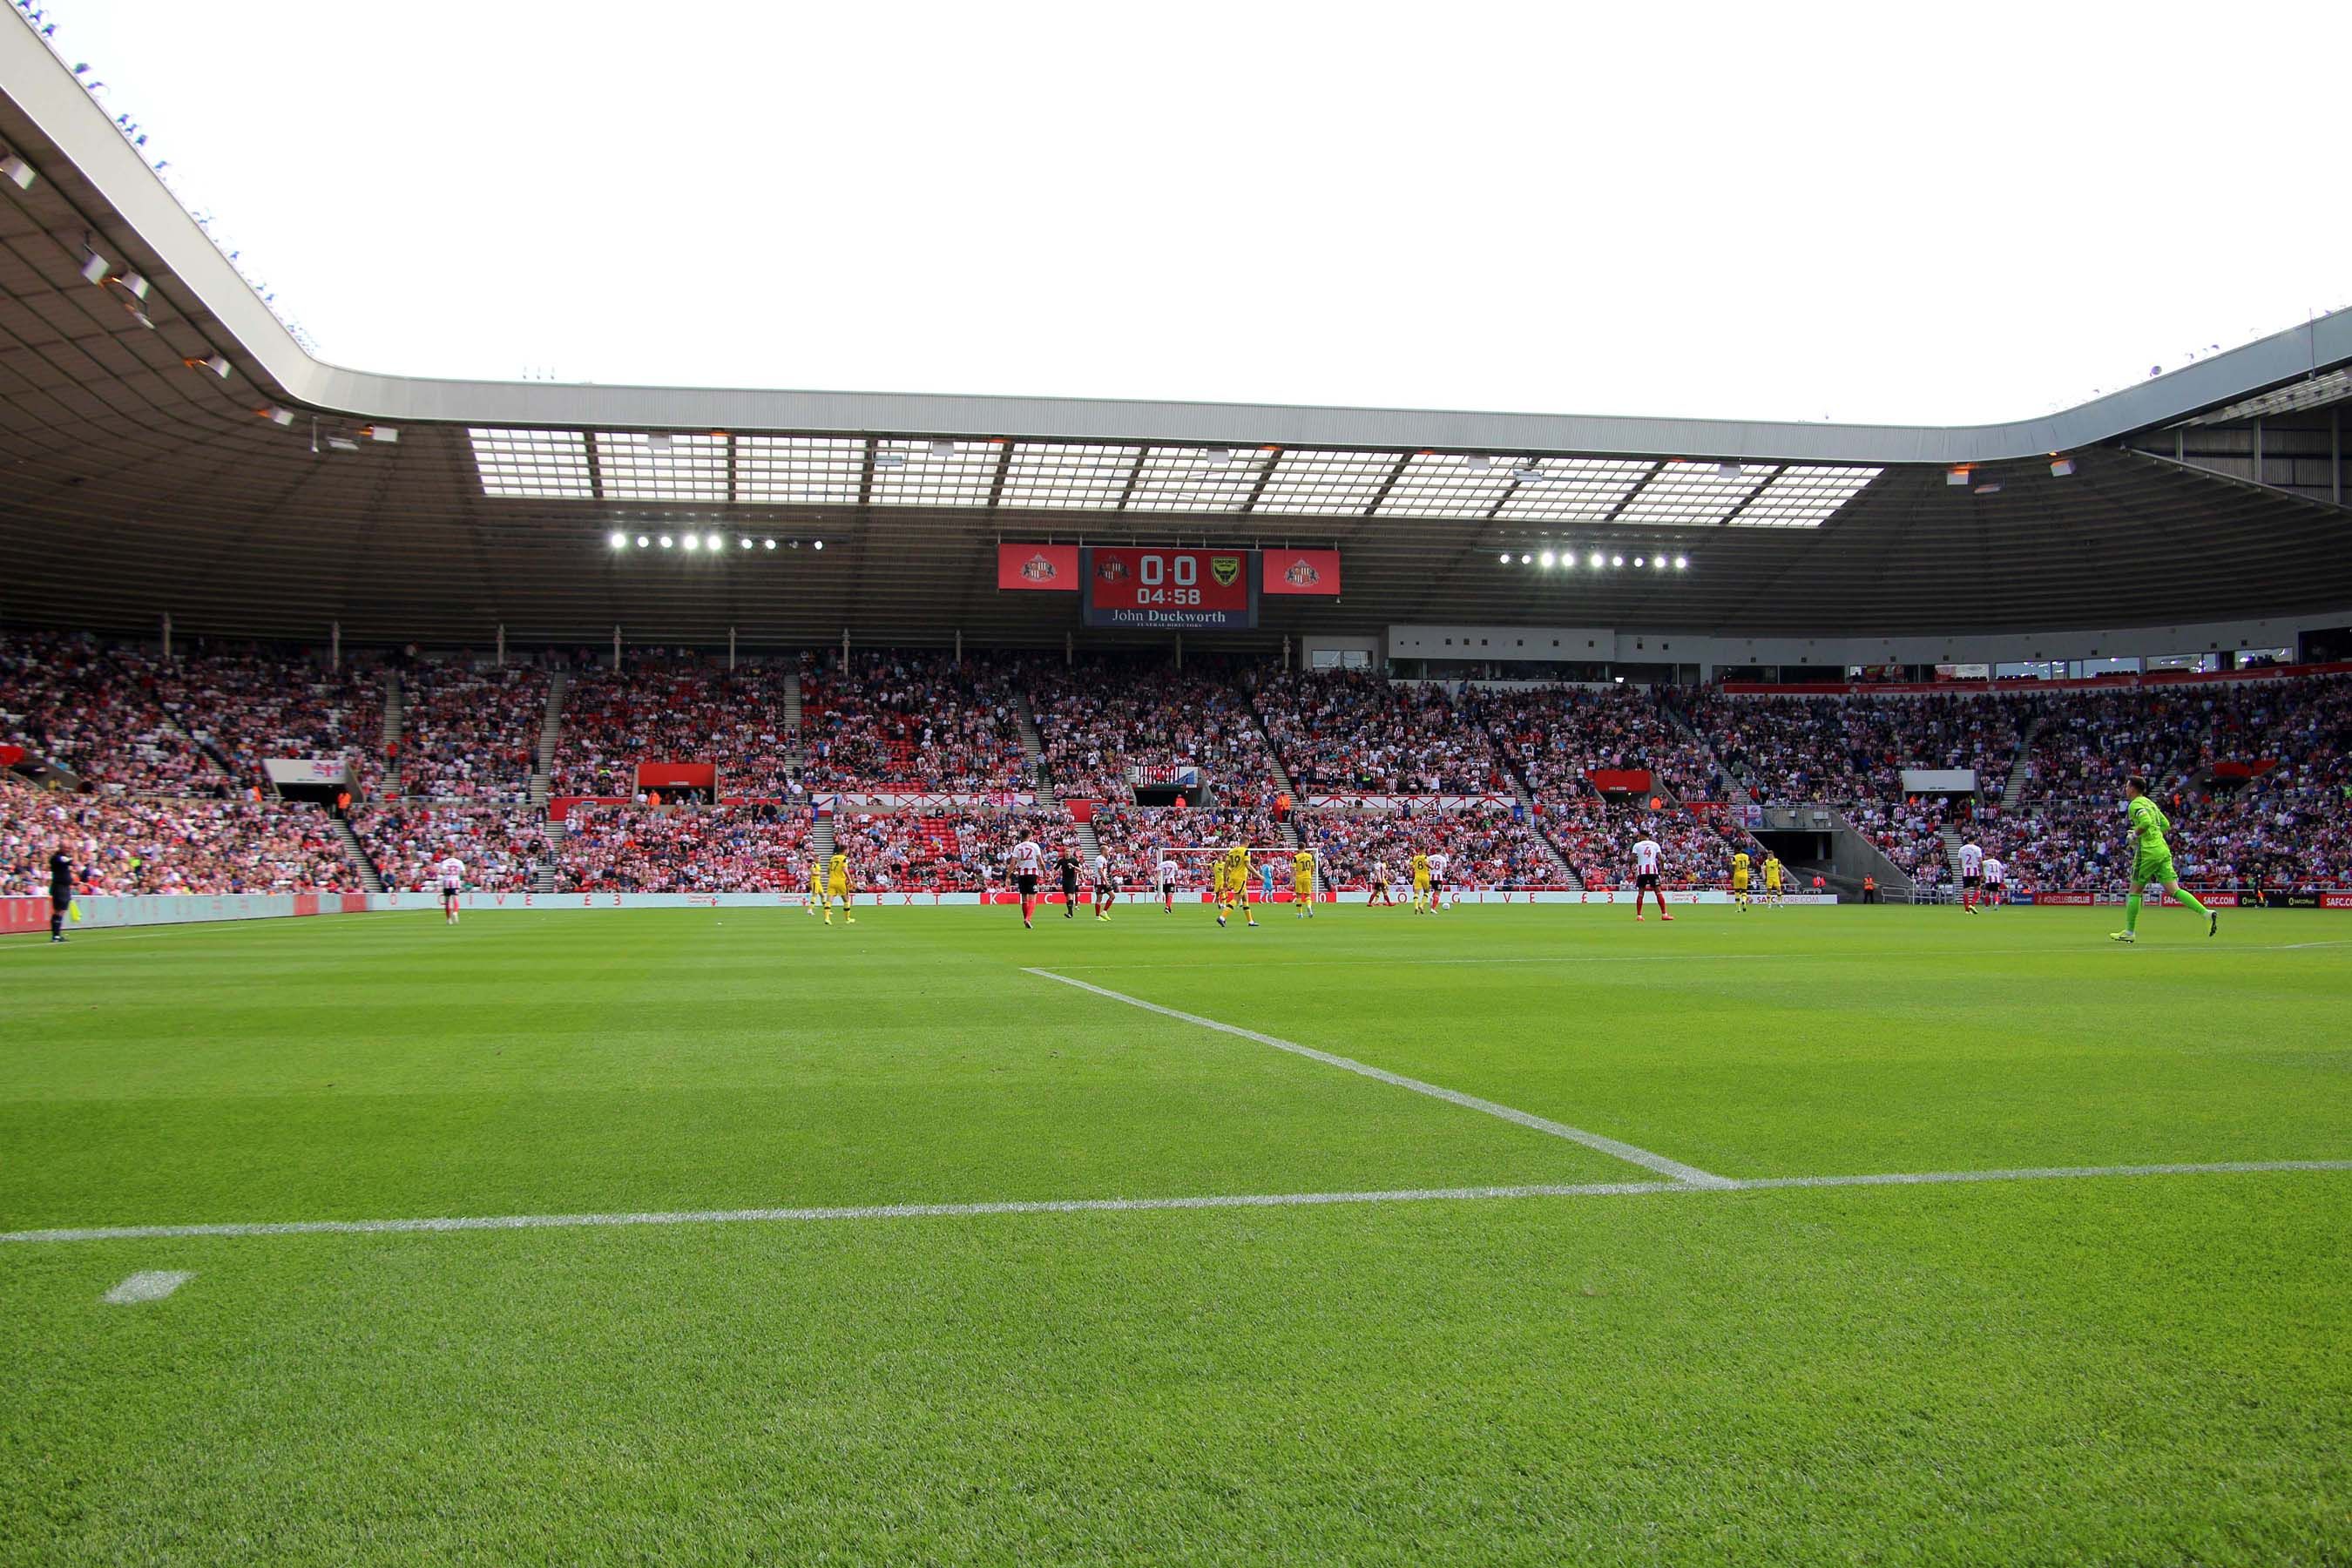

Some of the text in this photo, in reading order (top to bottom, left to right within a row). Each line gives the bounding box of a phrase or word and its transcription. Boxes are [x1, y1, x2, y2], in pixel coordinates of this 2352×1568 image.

[1137, 588, 1200, 605] 04:58
[1112, 609, 1226, 622] John Duckworth
[1018, 847, 1032, 861] 12
[1643, 846, 1652, 857] 4
[1229, 855, 1240, 867] 19
[1417, 861, 1423, 869] 8
[1965, 855, 1972, 864] 2
[1301, 861, 1310, 872] 10
[2203, 896, 2235, 905] SAFC.COM
